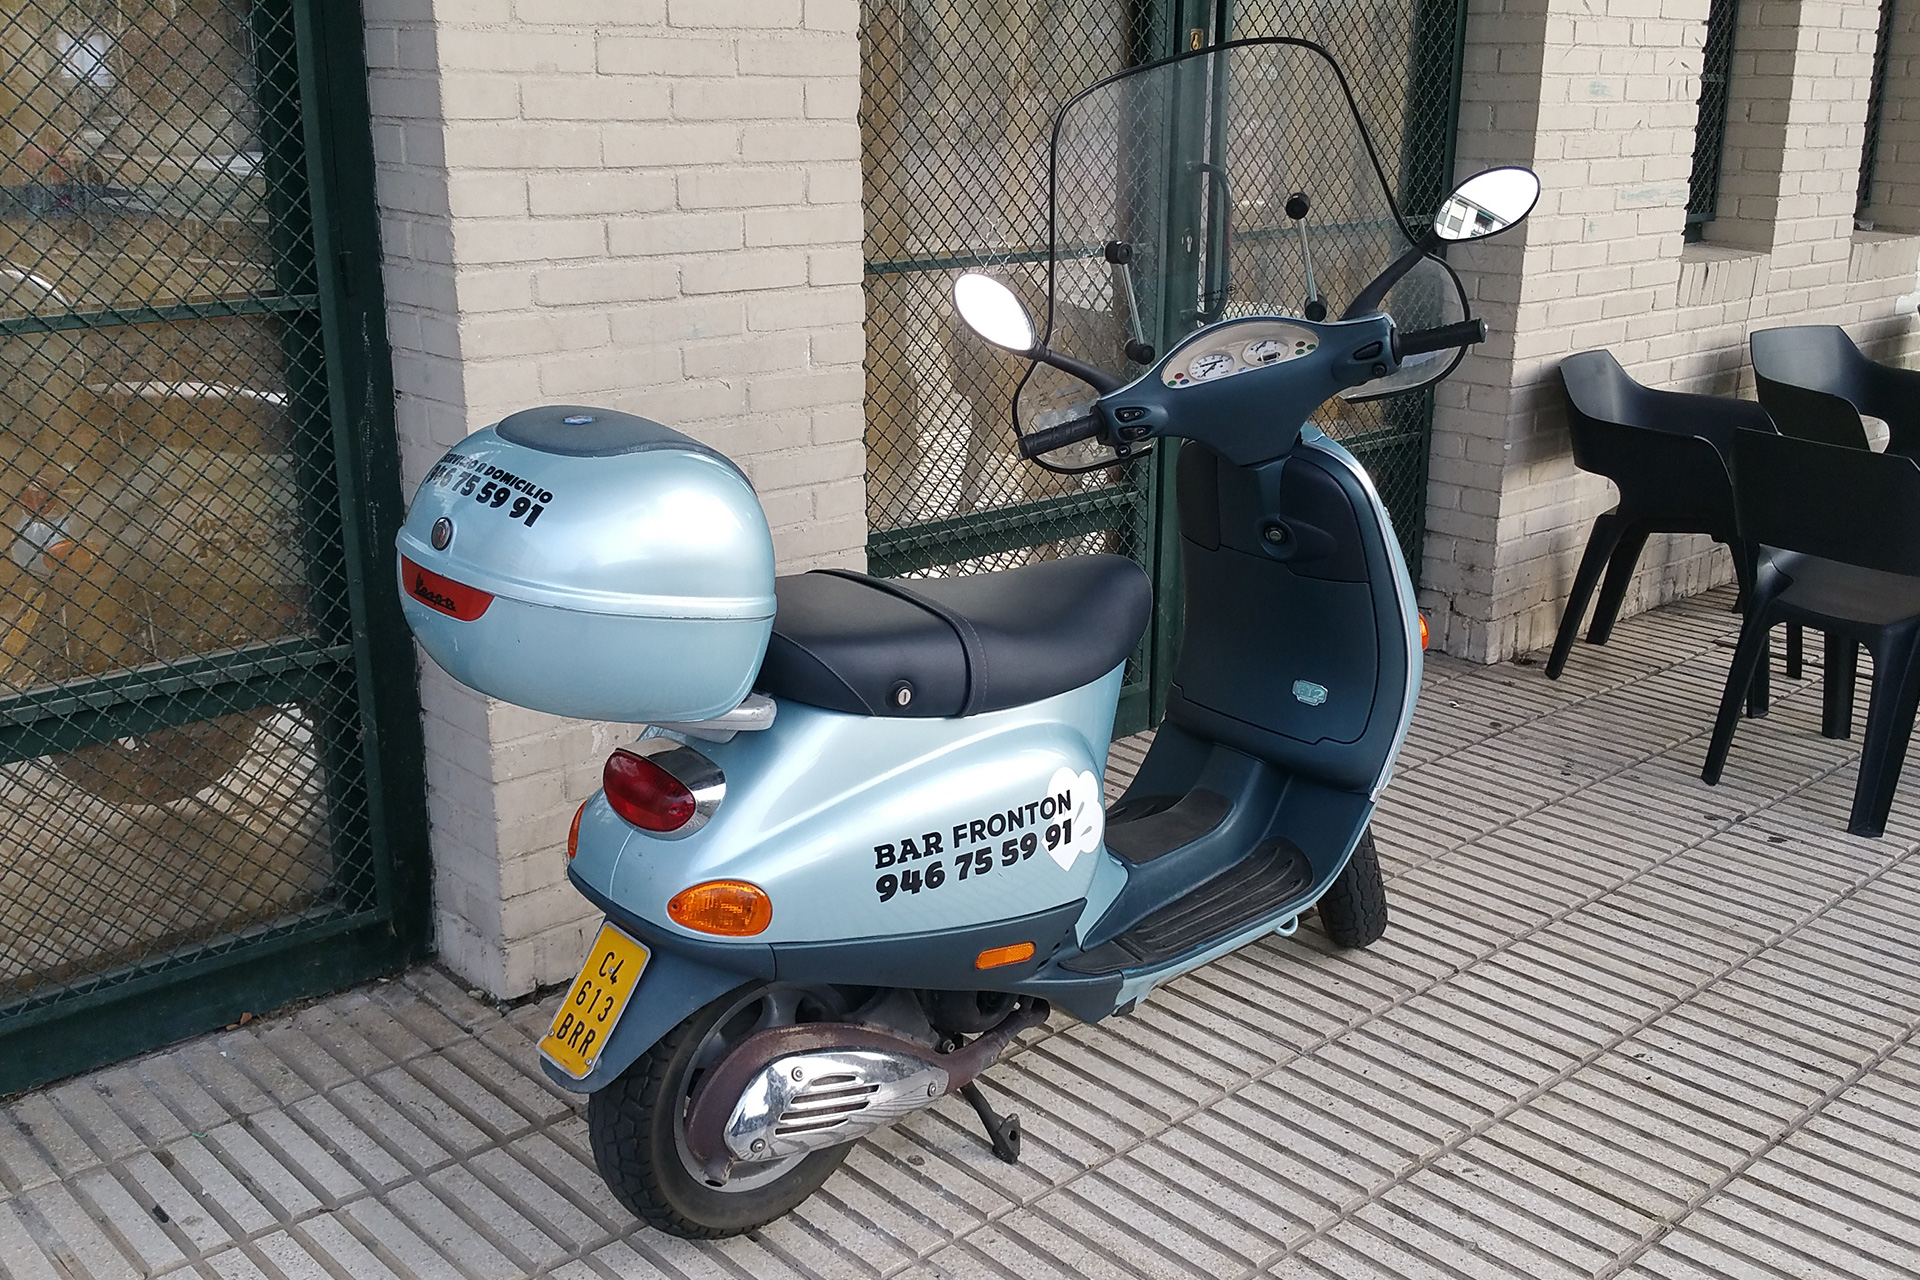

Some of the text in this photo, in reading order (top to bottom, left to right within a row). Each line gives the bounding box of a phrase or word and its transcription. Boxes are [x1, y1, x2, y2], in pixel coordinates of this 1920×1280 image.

[451, 471, 482, 497] 75
[476, 481, 511, 509] 59
[508, 497, 545, 528] 91
[475, 462, 487, 473] A
[483, 465, 553, 503] DOMICILIO
[413, 572, 456, 611] Vespa
[874, 790, 1072, 869] BAR FRONTON
[875, 818, 1072, 903] 946 75 59 91
[598, 951, 625, 986] C4
[575, 980, 615, 1022] 613
[556, 1012, 597, 1058] BRR
